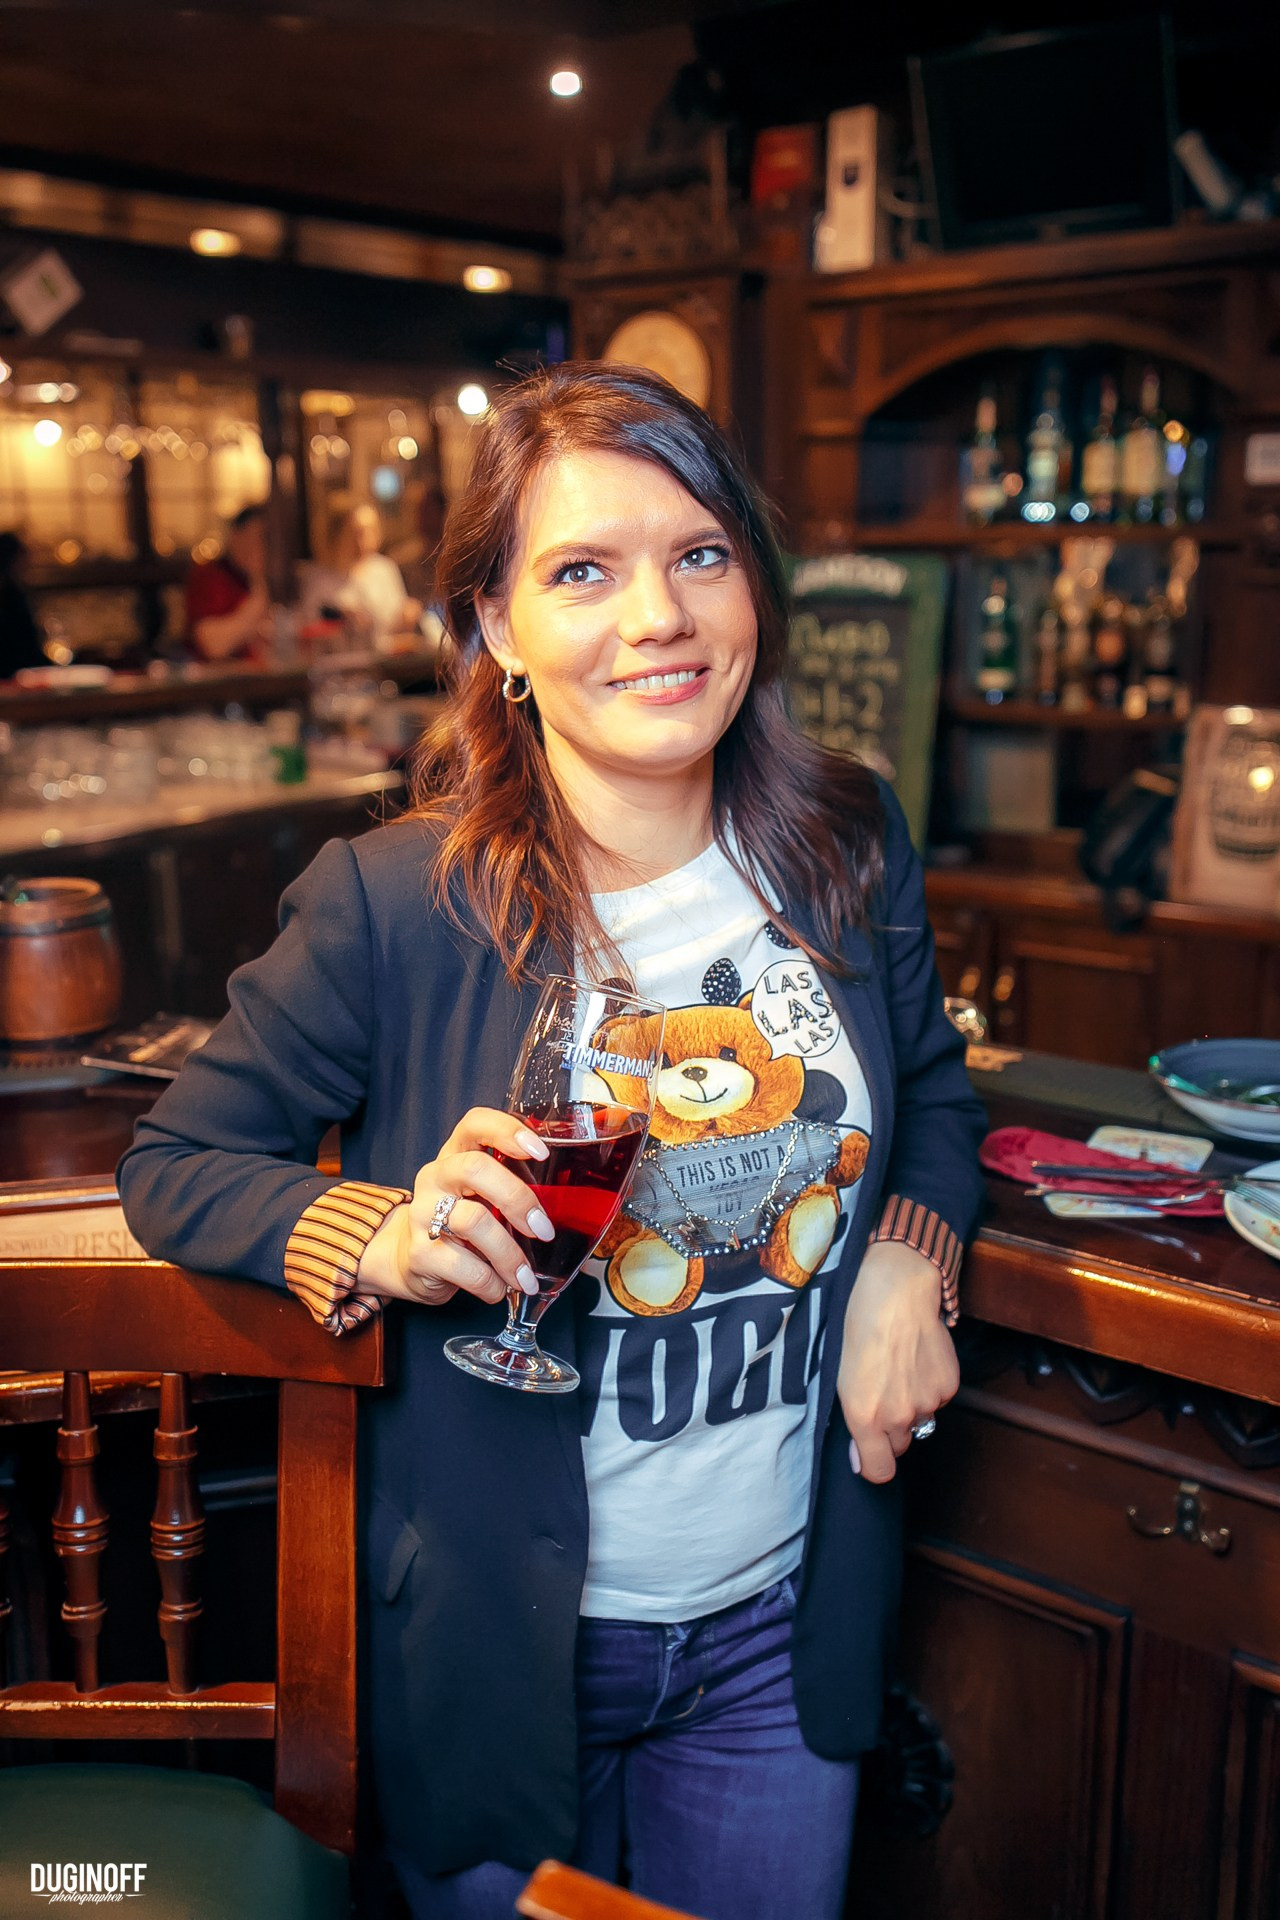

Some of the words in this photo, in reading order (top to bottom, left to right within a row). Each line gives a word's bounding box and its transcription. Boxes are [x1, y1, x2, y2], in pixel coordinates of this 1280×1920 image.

[763, 971, 813, 994] LAS
[757, 988, 834, 1037] LAS
[794, 1020, 834, 1054] LAS
[563, 1041, 655, 1079] TIMMERMANS
[677, 1160, 716, 1188] THIS
[718, 1155, 737, 1179] IS
[739, 1147, 771, 1174] NOT
